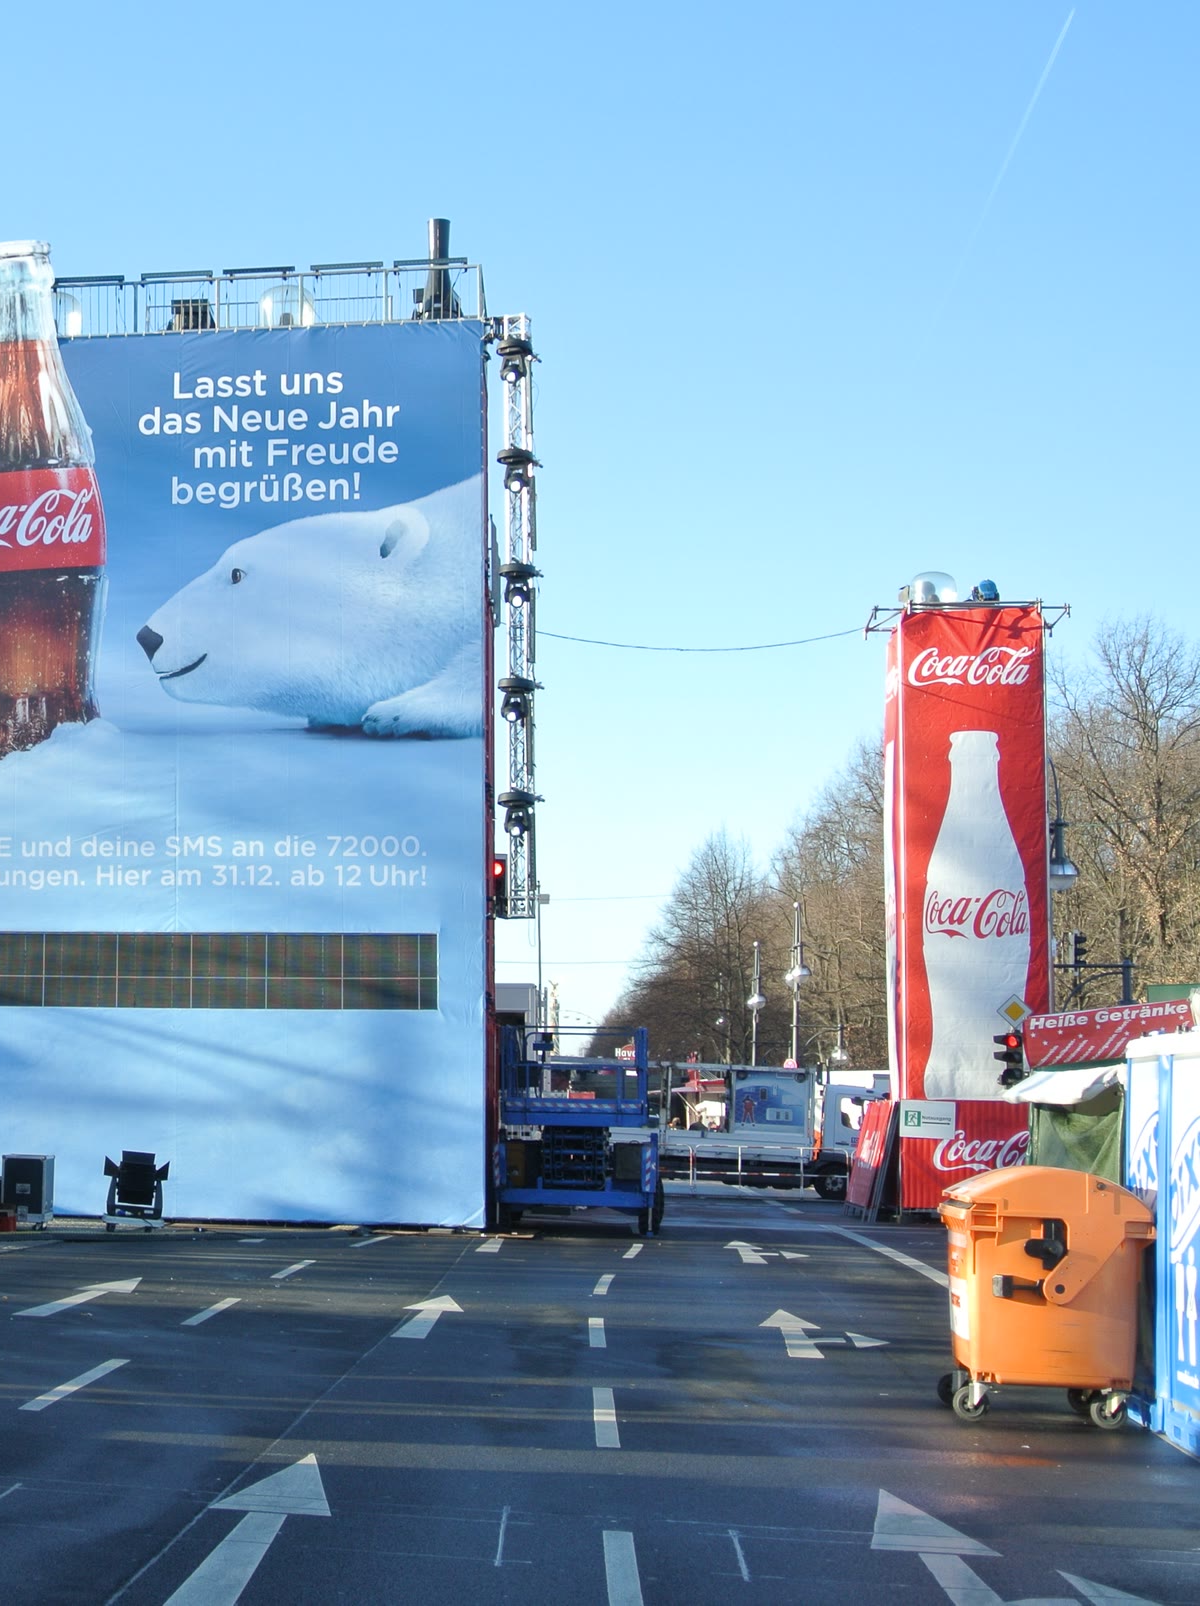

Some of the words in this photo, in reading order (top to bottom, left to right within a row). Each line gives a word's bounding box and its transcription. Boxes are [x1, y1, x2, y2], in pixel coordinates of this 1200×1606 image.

[172, 370, 267, 400] Lasst
[280, 371, 344, 396] uns
[138, 406, 202, 436] das
[214, 405, 308, 433] Neue
[318, 400, 400, 430] Jahr
[194, 440, 253, 469] mit
[267, 435, 399, 467] Freude
[171, 472, 362, 510] begrüßen!
[908, 646, 1036, 687] Coca-Cola
[21, 835, 71, 858] und
[80, 835, 155, 858] deine
[165, 835, 222, 858] SMS
[232, 840, 264, 857] an
[274, 835, 316, 857] die
[327, 835, 427, 858] 72000.
[96, 864, 151, 887] Hier
[161, 869, 201, 887] am
[212, 864, 280, 887] 31.12.
[290, 864, 324, 886] ab
[334, 864, 361, 886] 12
[369, 864, 427, 886] Uhr!
[924, 888, 1030, 939] Coca-Cola
[1029, 1014, 1089, 1031] Heiße
[1095, 1003, 1189, 1023] Getränke
